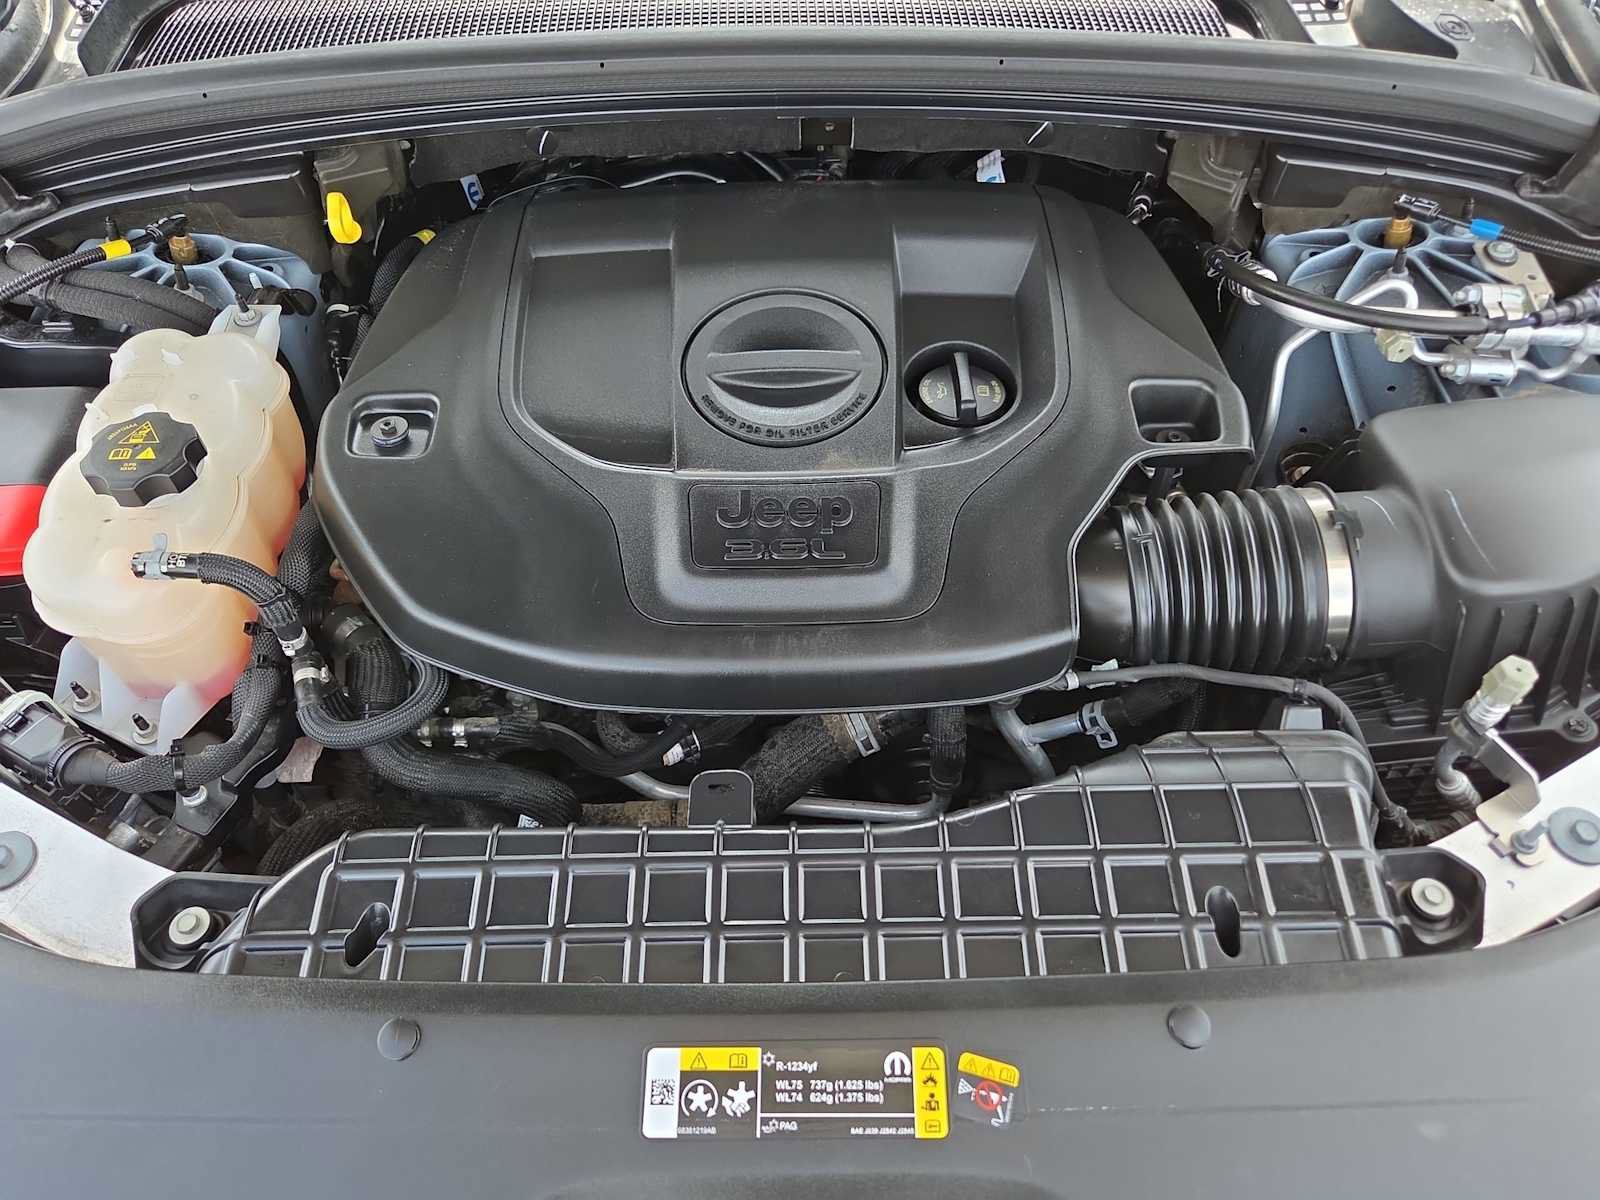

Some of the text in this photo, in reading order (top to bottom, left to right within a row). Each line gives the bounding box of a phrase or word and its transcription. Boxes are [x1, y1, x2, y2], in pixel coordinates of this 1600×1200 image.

[766, 427, 785, 438] OIL
[788, 421, 829, 438] FILTER
[831, 392, 868, 425] SERVICE
[716, 489, 854, 534] Jeep
[724, 538, 847, 561] 3.6L
[775, 1061, 818, 1073] R-1234yf
[775, 1080, 803, 1090] WL75
[809, 1080, 833, 1092] 737g
[865, 1080, 884, 1092] lbs)
[775, 1092, 803, 1103] WL74
[834, 1092, 864, 1104] (1.375
[865, 1092, 884, 1104] lbs)
[779, 1121, 798, 1131] PAG
